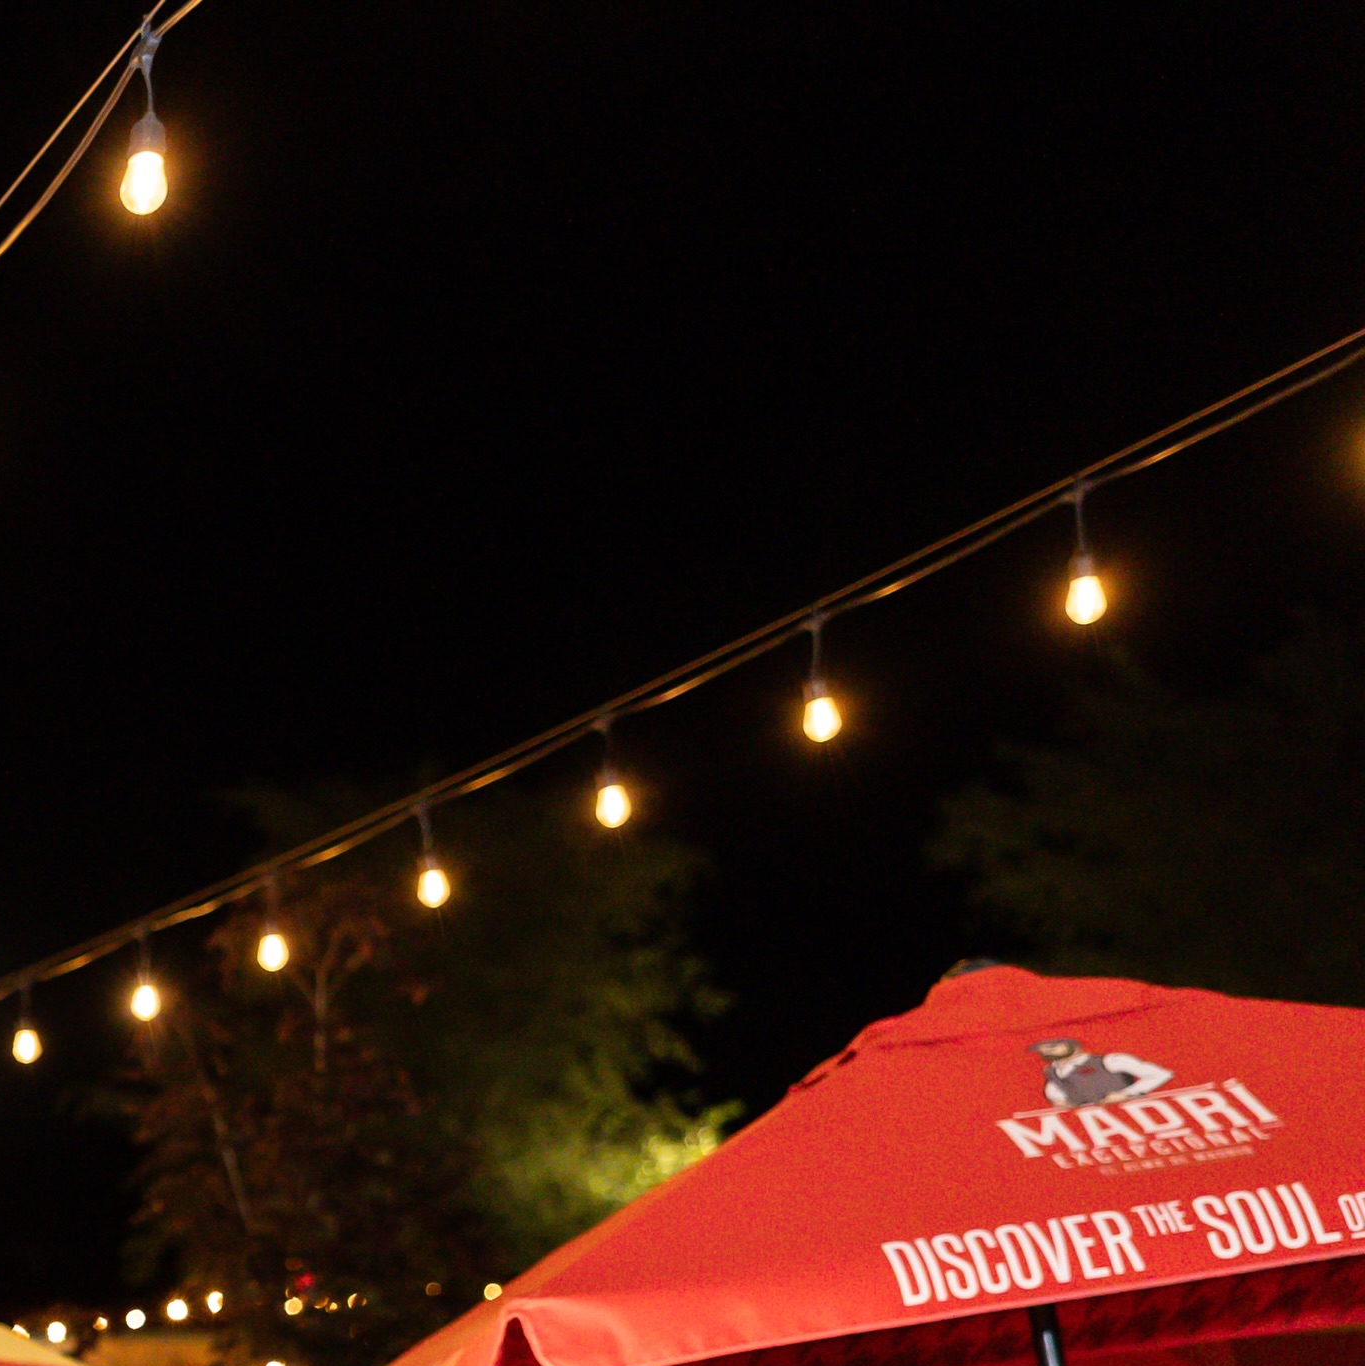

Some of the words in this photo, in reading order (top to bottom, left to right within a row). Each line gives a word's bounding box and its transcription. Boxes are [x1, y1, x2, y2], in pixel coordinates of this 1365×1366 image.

[881, 1210, 1145, 1307] DISCOVER
[1130, 1199, 1194, 1237] THE
[1192, 1181, 1343, 1259] SOUL
